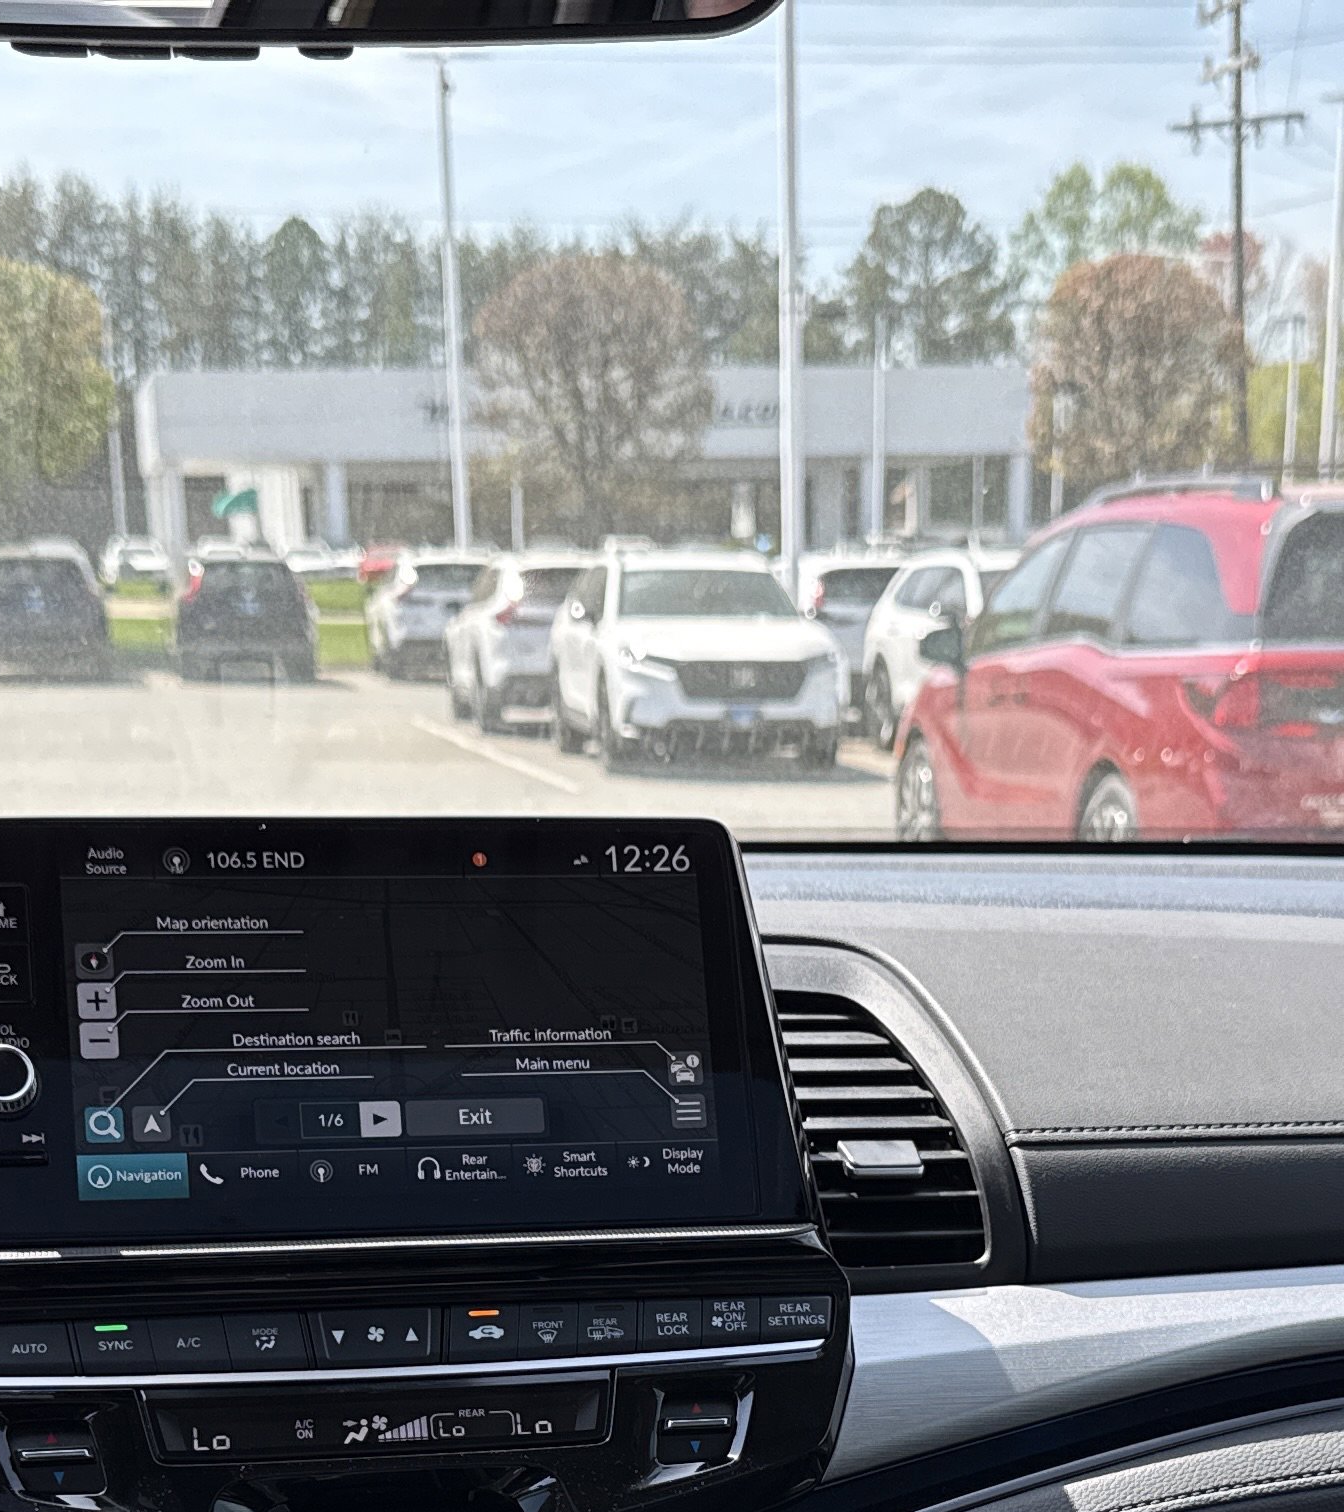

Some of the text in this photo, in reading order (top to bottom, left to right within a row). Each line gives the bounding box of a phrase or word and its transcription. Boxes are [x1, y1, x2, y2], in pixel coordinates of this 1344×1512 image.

[88, 848, 124, 859] Audio
[605, 844, 690, 872] 12:26
[207, 851, 305, 869] 106.5 END
[86, 863, 127, 875] Source
[156, 916, 269, 932] Map orientation
[185, 955, 245, 969] Zoom In
[181, 994, 255, 1008] Zoom Out
[232, 1031, 361, 1047] Destination search
[488, 1027, 612, 1042] Traffic information
[227, 1062, 340, 1076] Current location
[515, 1057, 590, 1070] Main menu
[318, 1113, 344, 1127] 1/6
[459, 1108, 493, 1125] Exit
[462, 1154, 488, 1165] Rear
[563, 1151, 596, 1162] Smart
[662, 1147, 704, 1161] Display
[240, 1167, 280, 1179] Phone
[358, 1164, 379, 1176] FM
[554, 1165, 608, 1178] Shortcuts
[667, 1162, 701, 1175] Mode
[116, 1167, 182, 1183] Navigation
[713, 1301, 746, 1312] REAR
[779, 1302, 811, 1314] REAR
[592, 1318, 618, 1327] REAR
[656, 1312, 688, 1324] REAR
[724, 1312, 745, 1322] ON/
[767, 1314, 825, 1327] SETTINGS
[532, 1320, 564, 1330] FRONT
[657, 1324, 689, 1336] LOCK
[725, 1321, 748, 1332] OFF
[252, 1327, 279, 1336] MODE
[11, 1343, 48, 1354] AUTO
[97, 1339, 134, 1351] SYNC
[176, 1337, 201, 1349] A/C
[458, 1408, 486, 1418] REAR
[295, 1418, 314, 1429] A/C
[296, 1429, 314, 1440] ON
